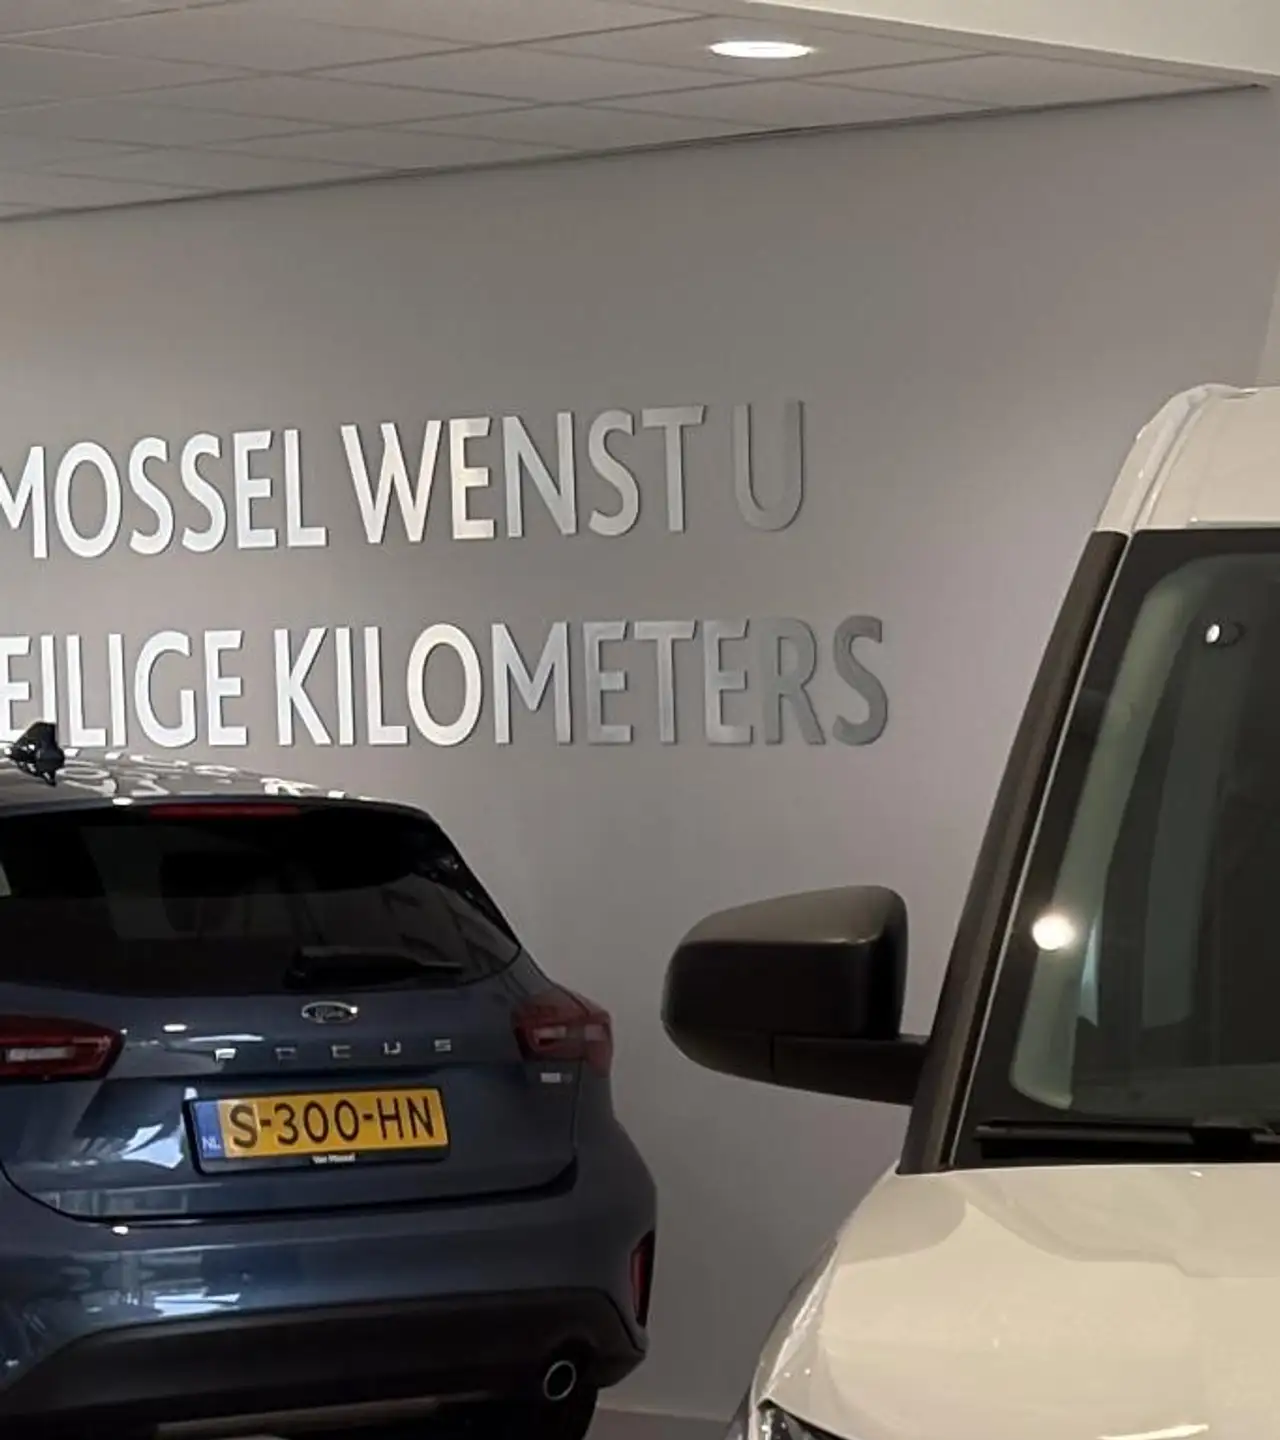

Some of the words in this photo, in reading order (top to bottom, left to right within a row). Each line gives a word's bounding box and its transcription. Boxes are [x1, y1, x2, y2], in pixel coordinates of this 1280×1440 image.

[0, 429, 328, 559] MOSSEL
[341, 403, 707, 544] WENST
[733, 401, 805, 532] U
[0, 630, 247, 748] EILIGE
[274, 615, 889, 748] KILOMETERS
[202, 1135, 221, 1149] NL
[228, 1096, 435, 1151] S-300-HN
